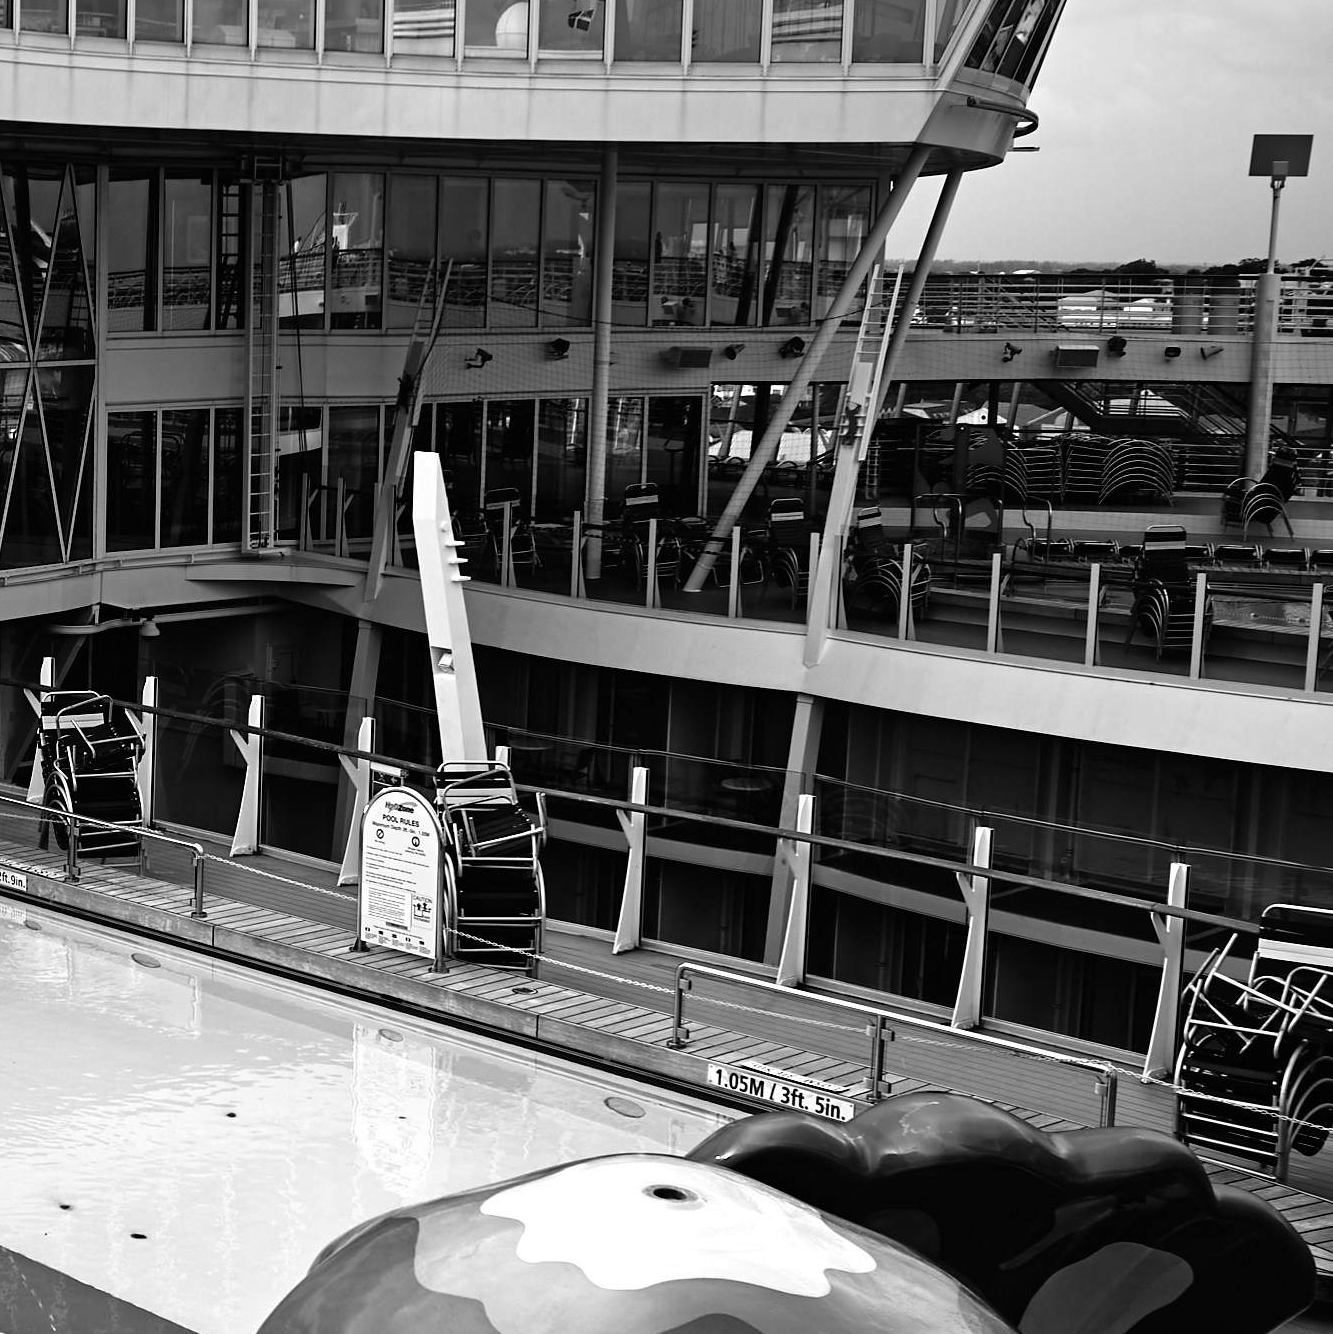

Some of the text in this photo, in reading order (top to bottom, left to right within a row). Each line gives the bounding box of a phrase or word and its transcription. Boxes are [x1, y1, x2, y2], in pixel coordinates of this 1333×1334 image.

[382, 814, 420, 828] POOL RULES
[716, 1069, 765, 1098] 1.05M
[769, 1083, 777, 1101] /
[780, 1086, 809, 1110] 3ft.
[815, 1095, 846, 1121] 5in.
